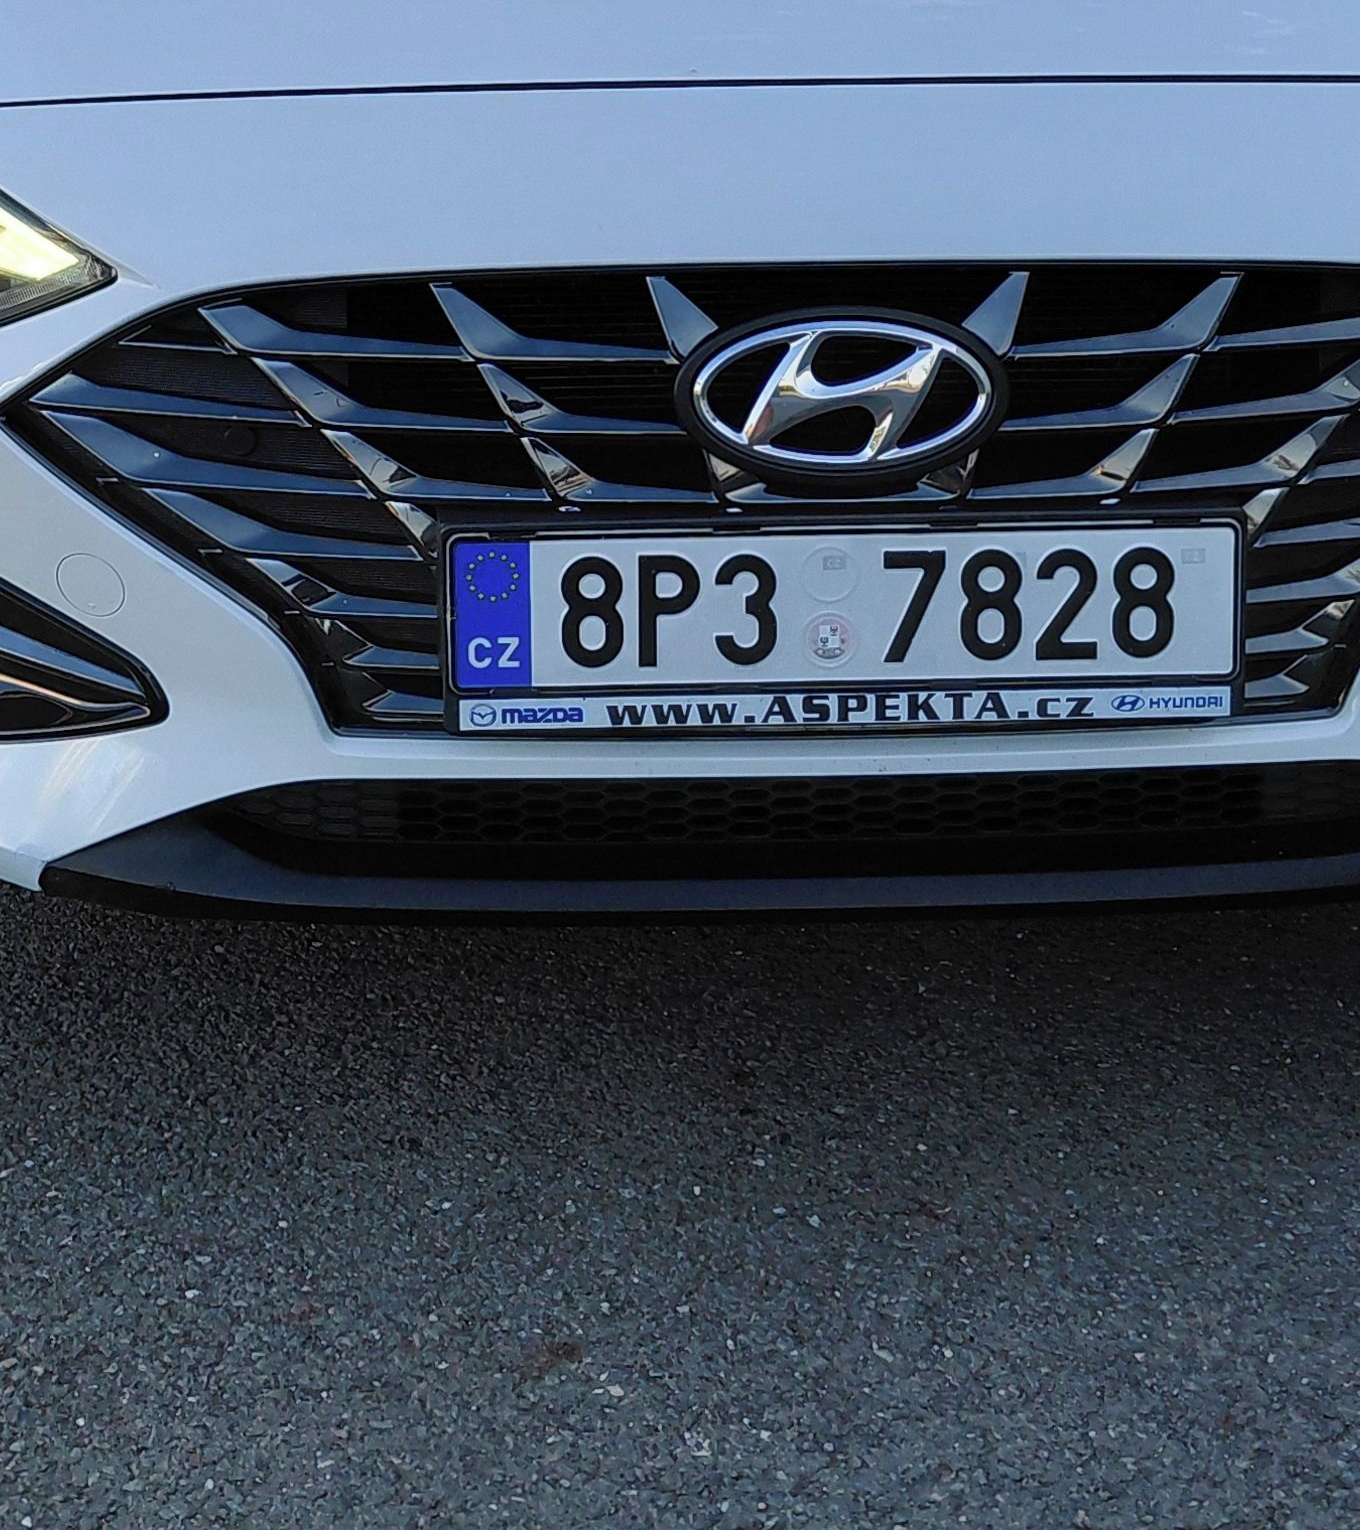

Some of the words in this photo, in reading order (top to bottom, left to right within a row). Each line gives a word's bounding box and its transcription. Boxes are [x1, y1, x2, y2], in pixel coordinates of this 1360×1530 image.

[559, 551, 778, 669] 8P3
[881, 546, 1177, 664] 7828
[466, 635, 521, 670] CZ
[1149, 695, 1223, 710] HYUNDAI
